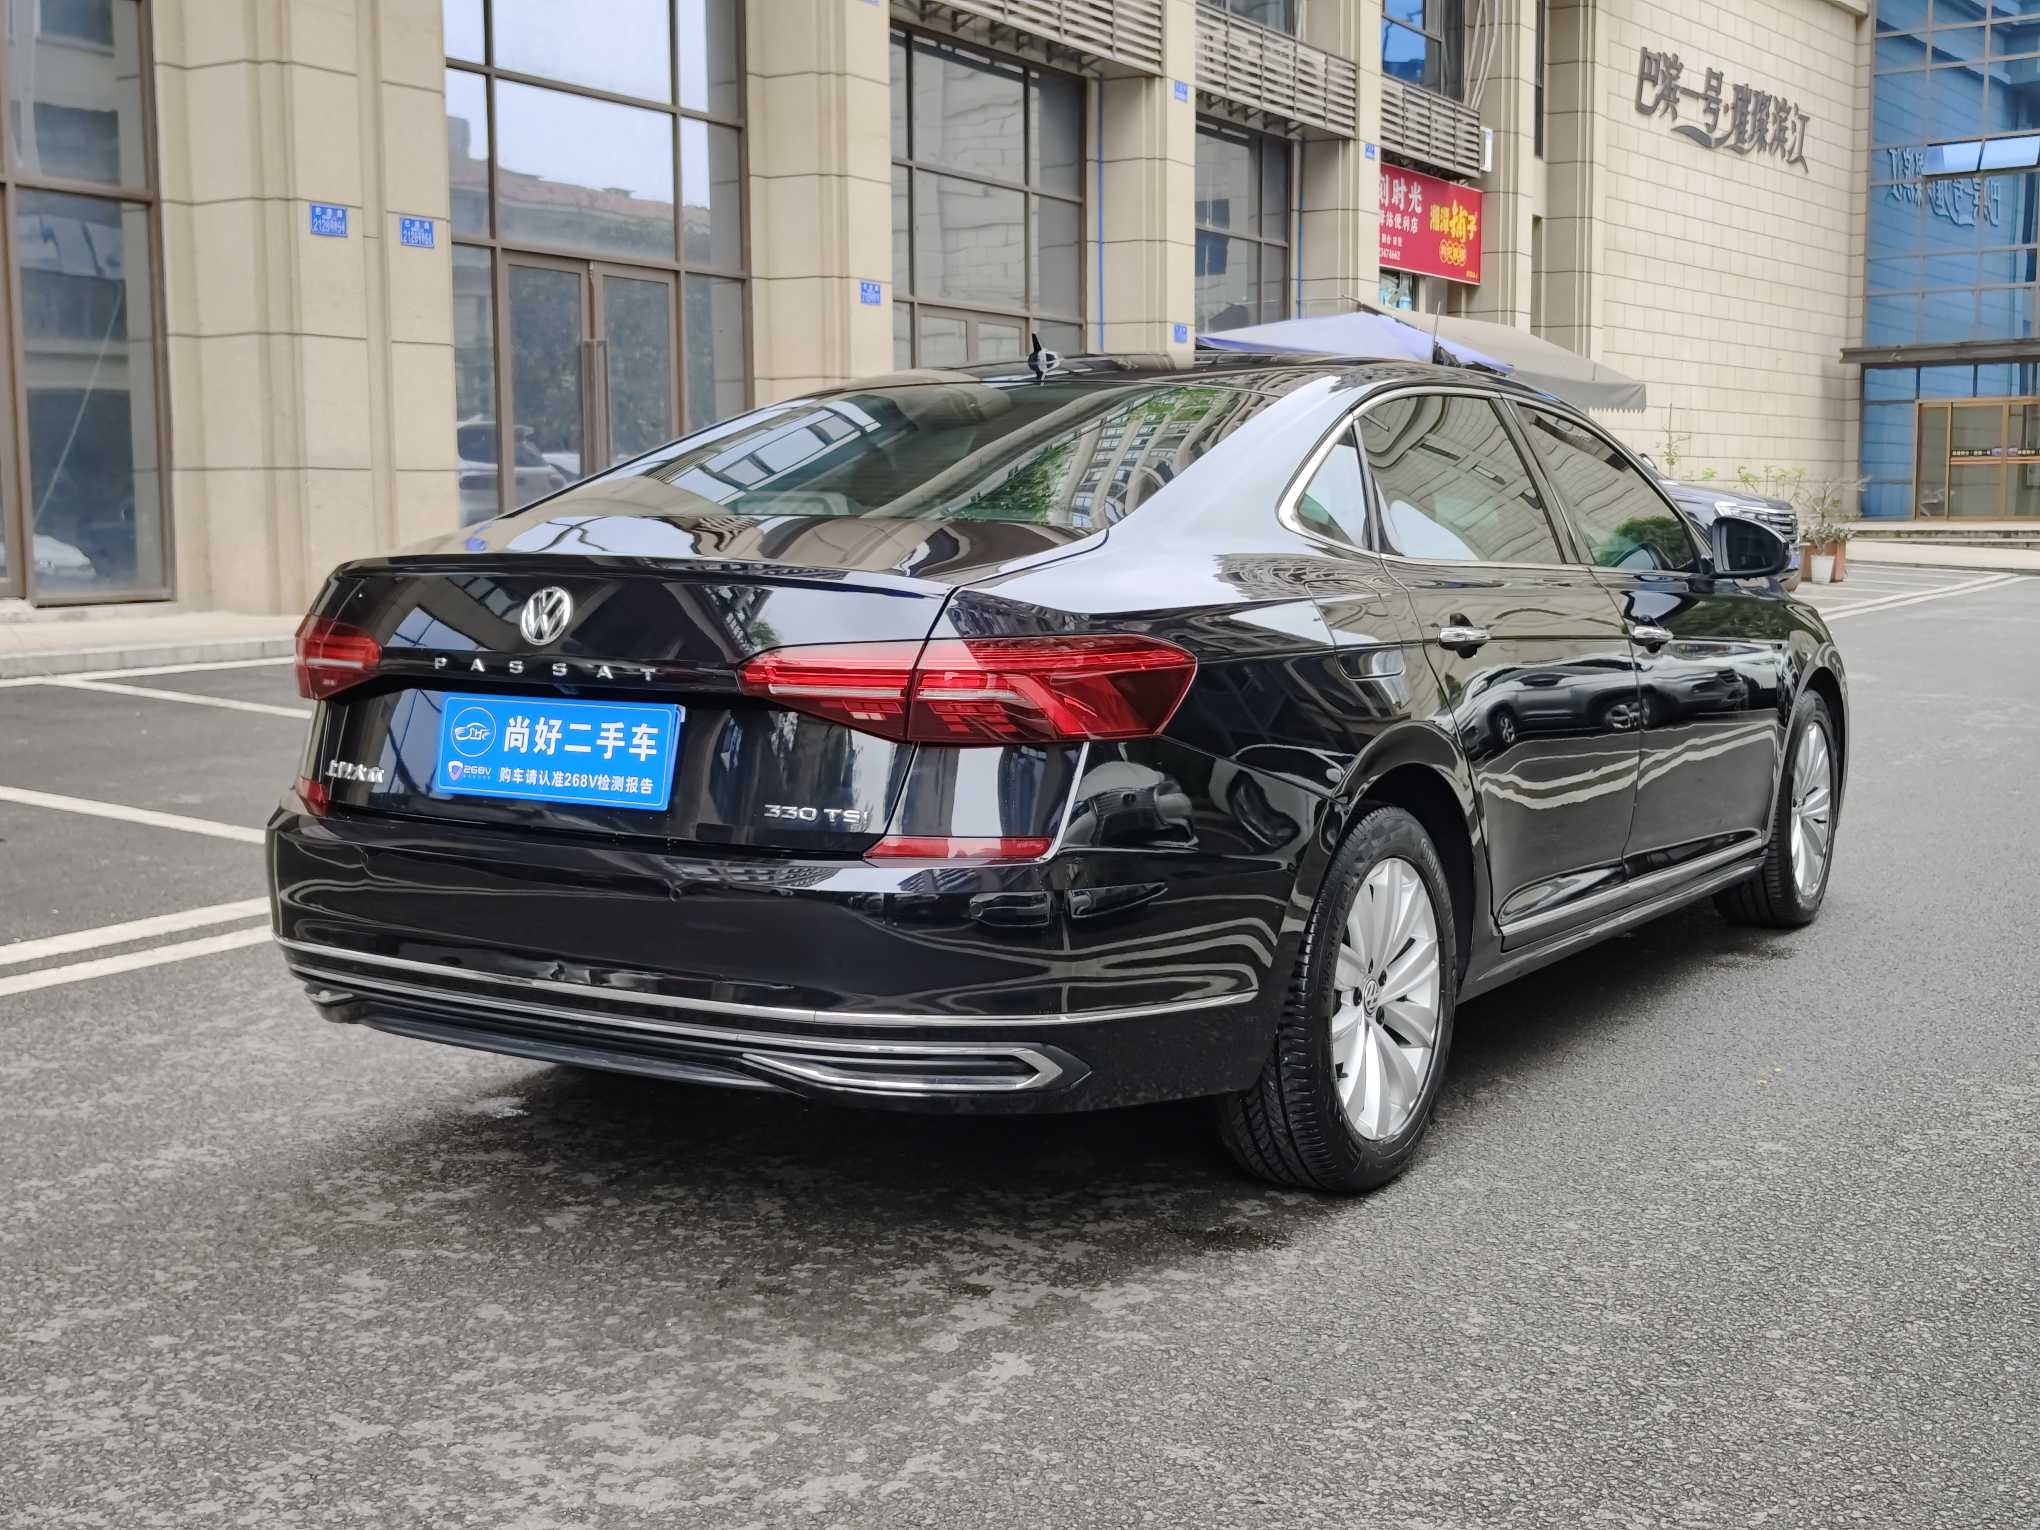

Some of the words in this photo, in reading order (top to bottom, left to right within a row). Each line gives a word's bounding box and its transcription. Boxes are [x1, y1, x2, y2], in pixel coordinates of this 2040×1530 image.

[434, 657, 657, 683] PASSAT
[504, 715, 659, 763] 尚好二手车
[498, 767, 654, 795] 购车请认准268V检测报告
[764, 804, 817, 821] 330
[823, 808, 869, 823] TSI
